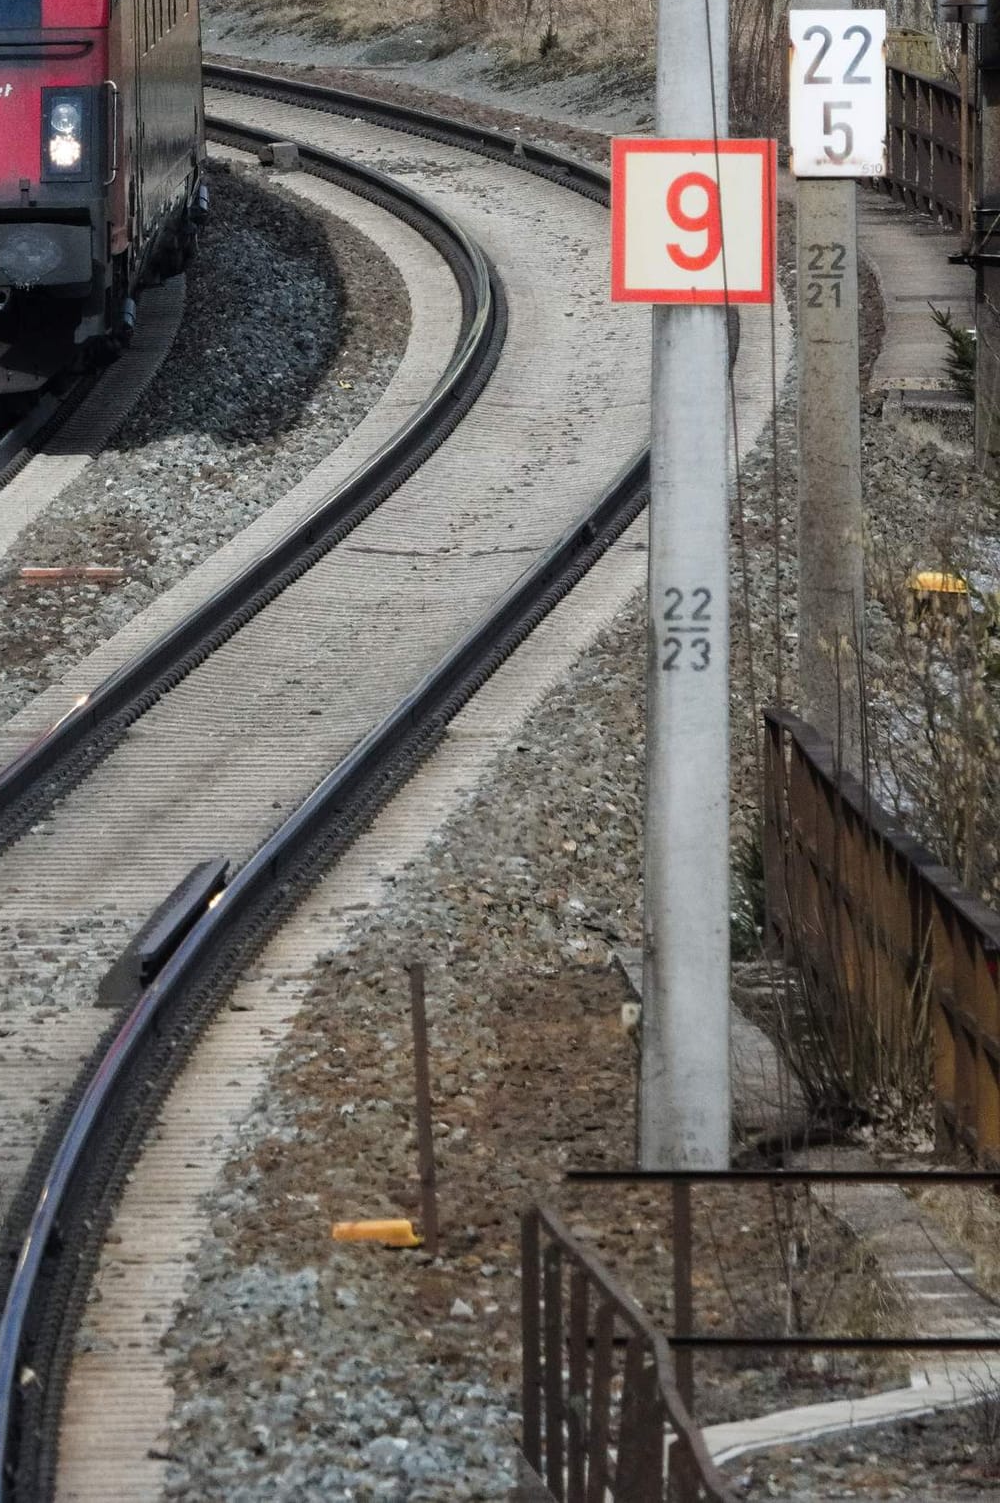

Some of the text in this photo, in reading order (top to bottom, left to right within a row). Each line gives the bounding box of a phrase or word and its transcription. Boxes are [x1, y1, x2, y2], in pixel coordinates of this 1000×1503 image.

[801, 24, 873, 86] 22
[822, 100, 854, 163] 5
[666, 171, 723, 271] 9
[807, 242, 847, 272] 22
[807, 282, 843, 309] 21
[663, 586, 712, 622] 22
[662, 636, 712, 673] 23
